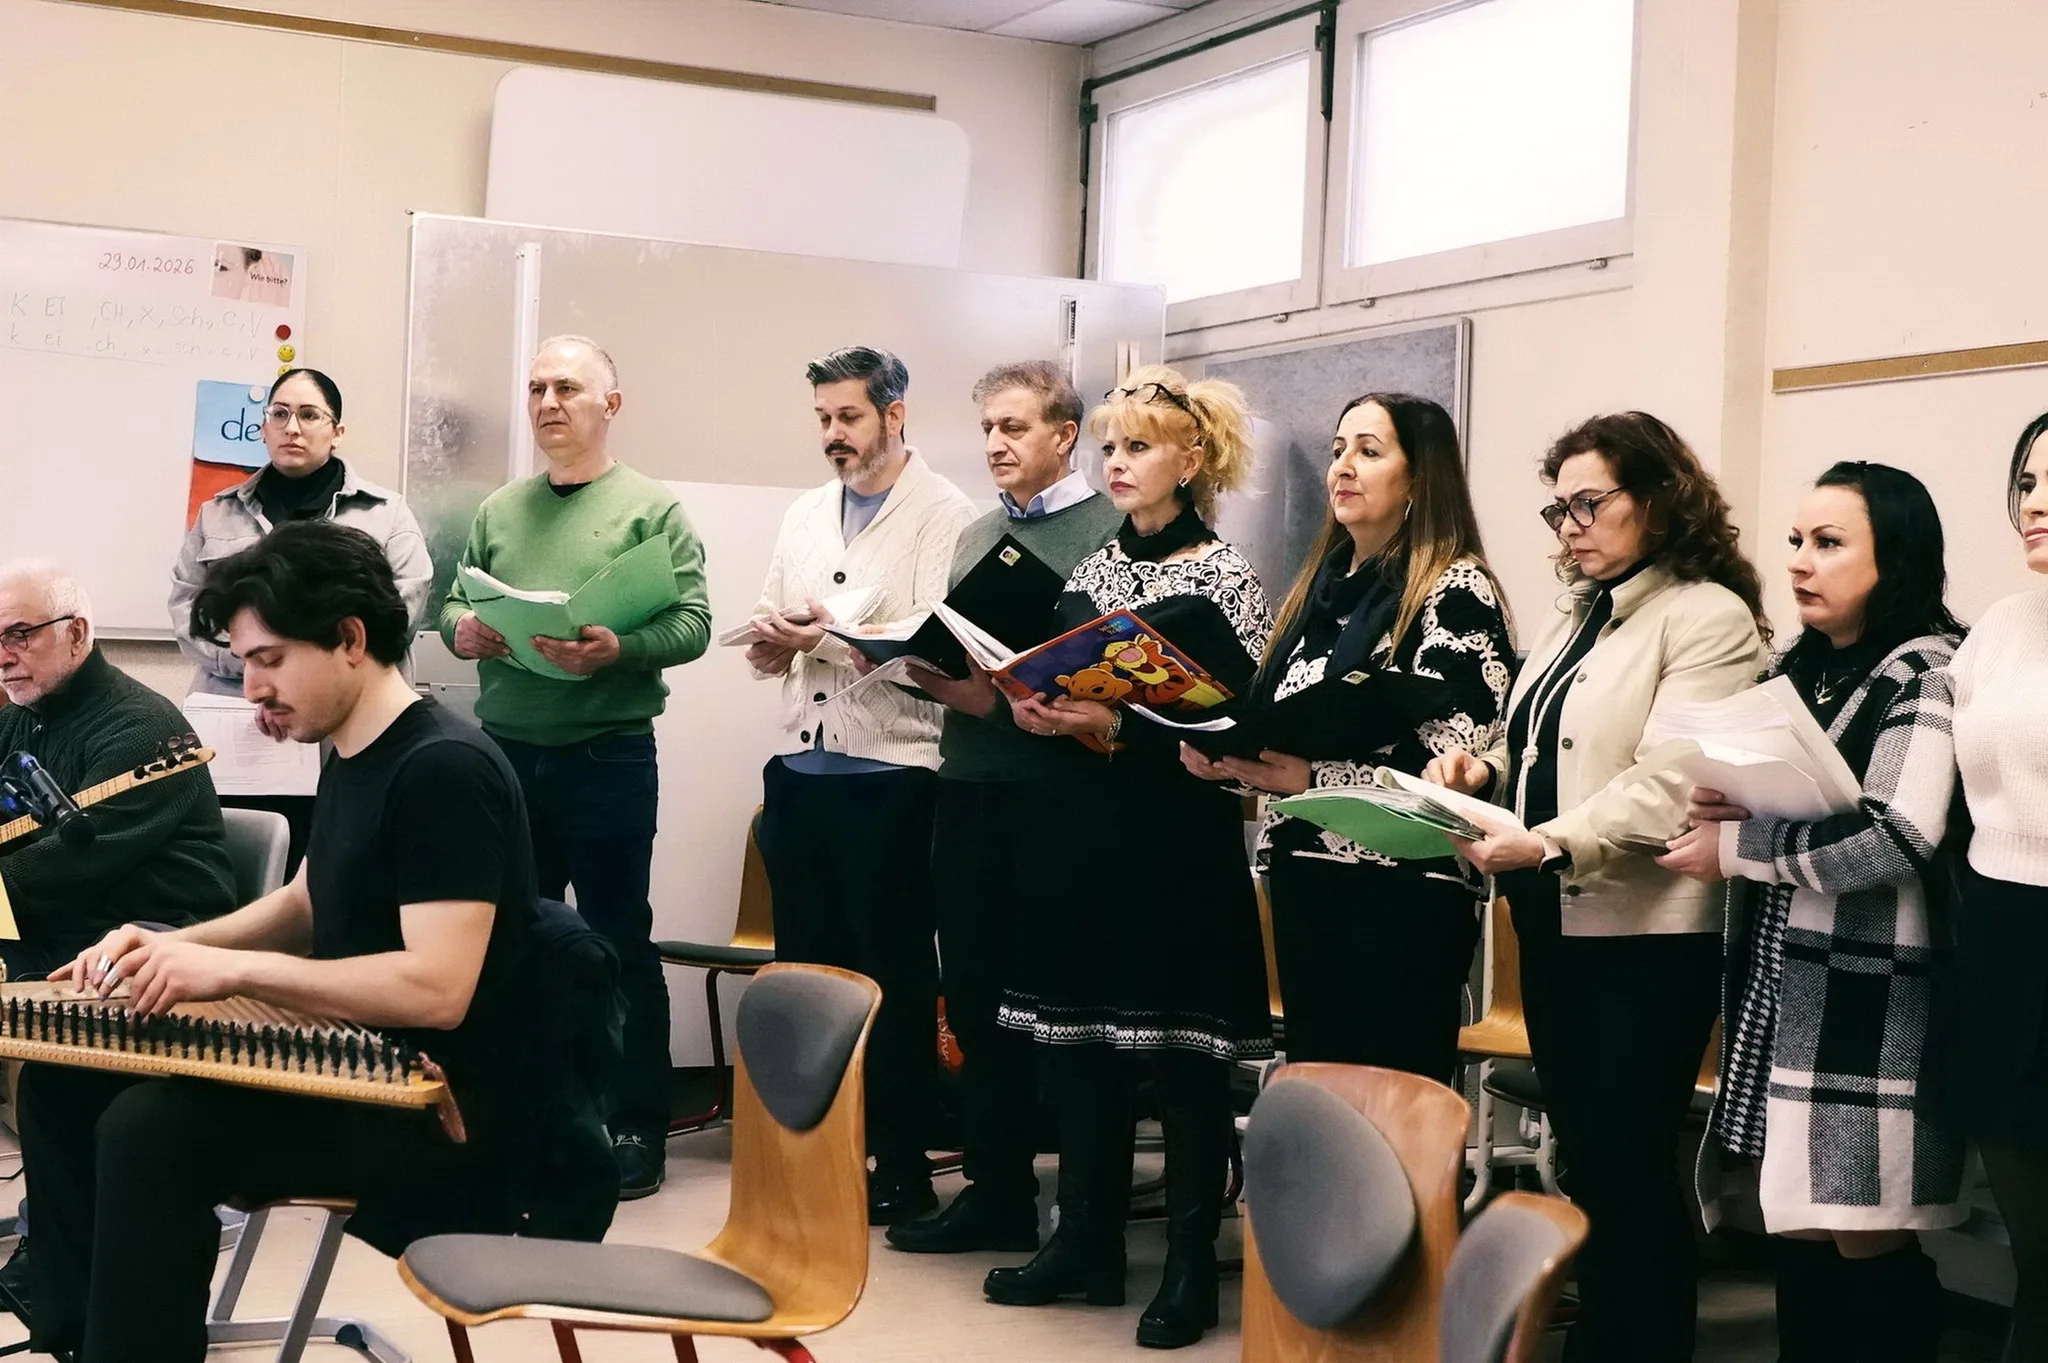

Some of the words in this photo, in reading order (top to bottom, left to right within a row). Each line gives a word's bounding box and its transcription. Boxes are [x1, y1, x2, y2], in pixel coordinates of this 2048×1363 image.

[99, 252, 194, 274] 29.01.2026
[250, 272, 265, 281] Wie
[266, 276, 288, 286] bitte?
[10, 292, 28, 317] K
